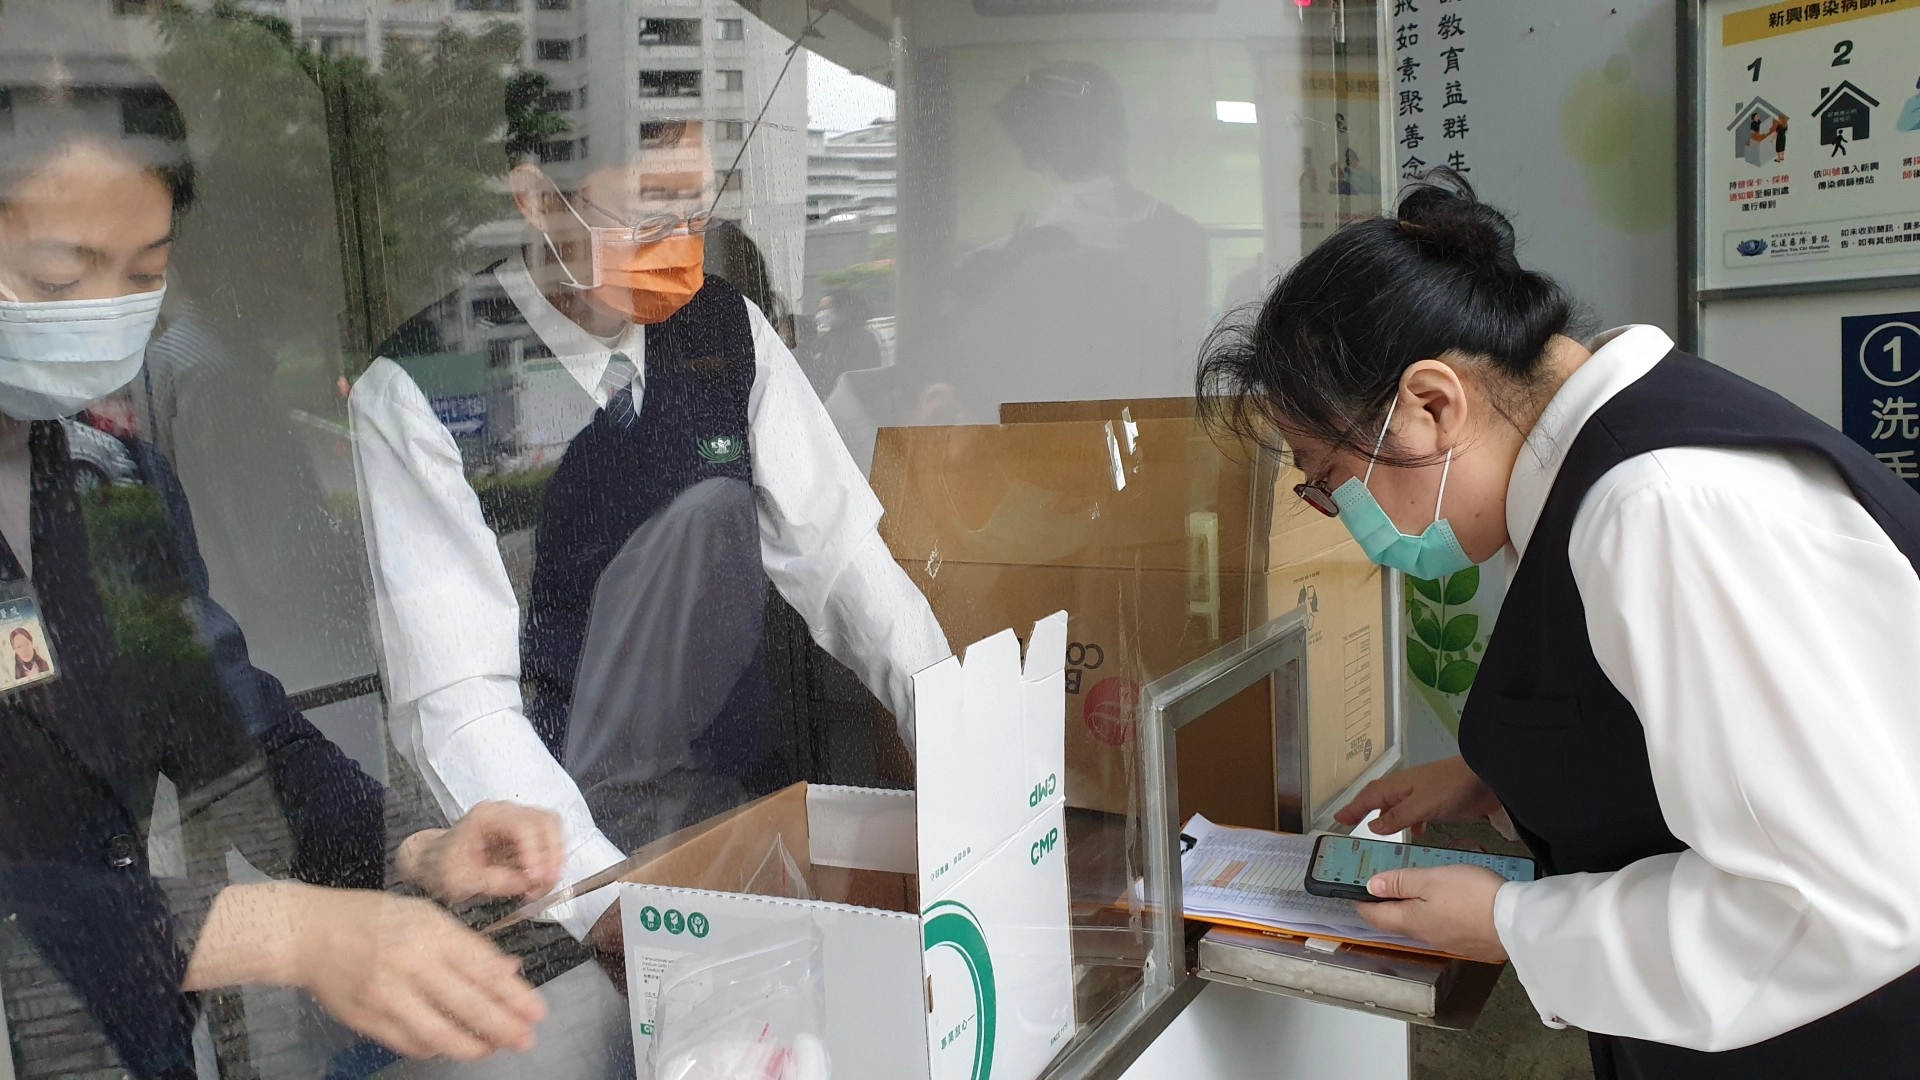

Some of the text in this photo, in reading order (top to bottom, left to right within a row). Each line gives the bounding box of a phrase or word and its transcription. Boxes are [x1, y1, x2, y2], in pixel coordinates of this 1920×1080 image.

[1768, 0, 1897, 28] 新興傳染病篩
[1747, 57, 1763, 82] 1
[1831, 40, 1854, 67] 2
[1437, 0, 1471, 173] 教育益群生
[1883, 335, 1902, 372] 1
[1029, 772, 1057, 808] CMP
[1030, 827, 1058, 865] CMP
